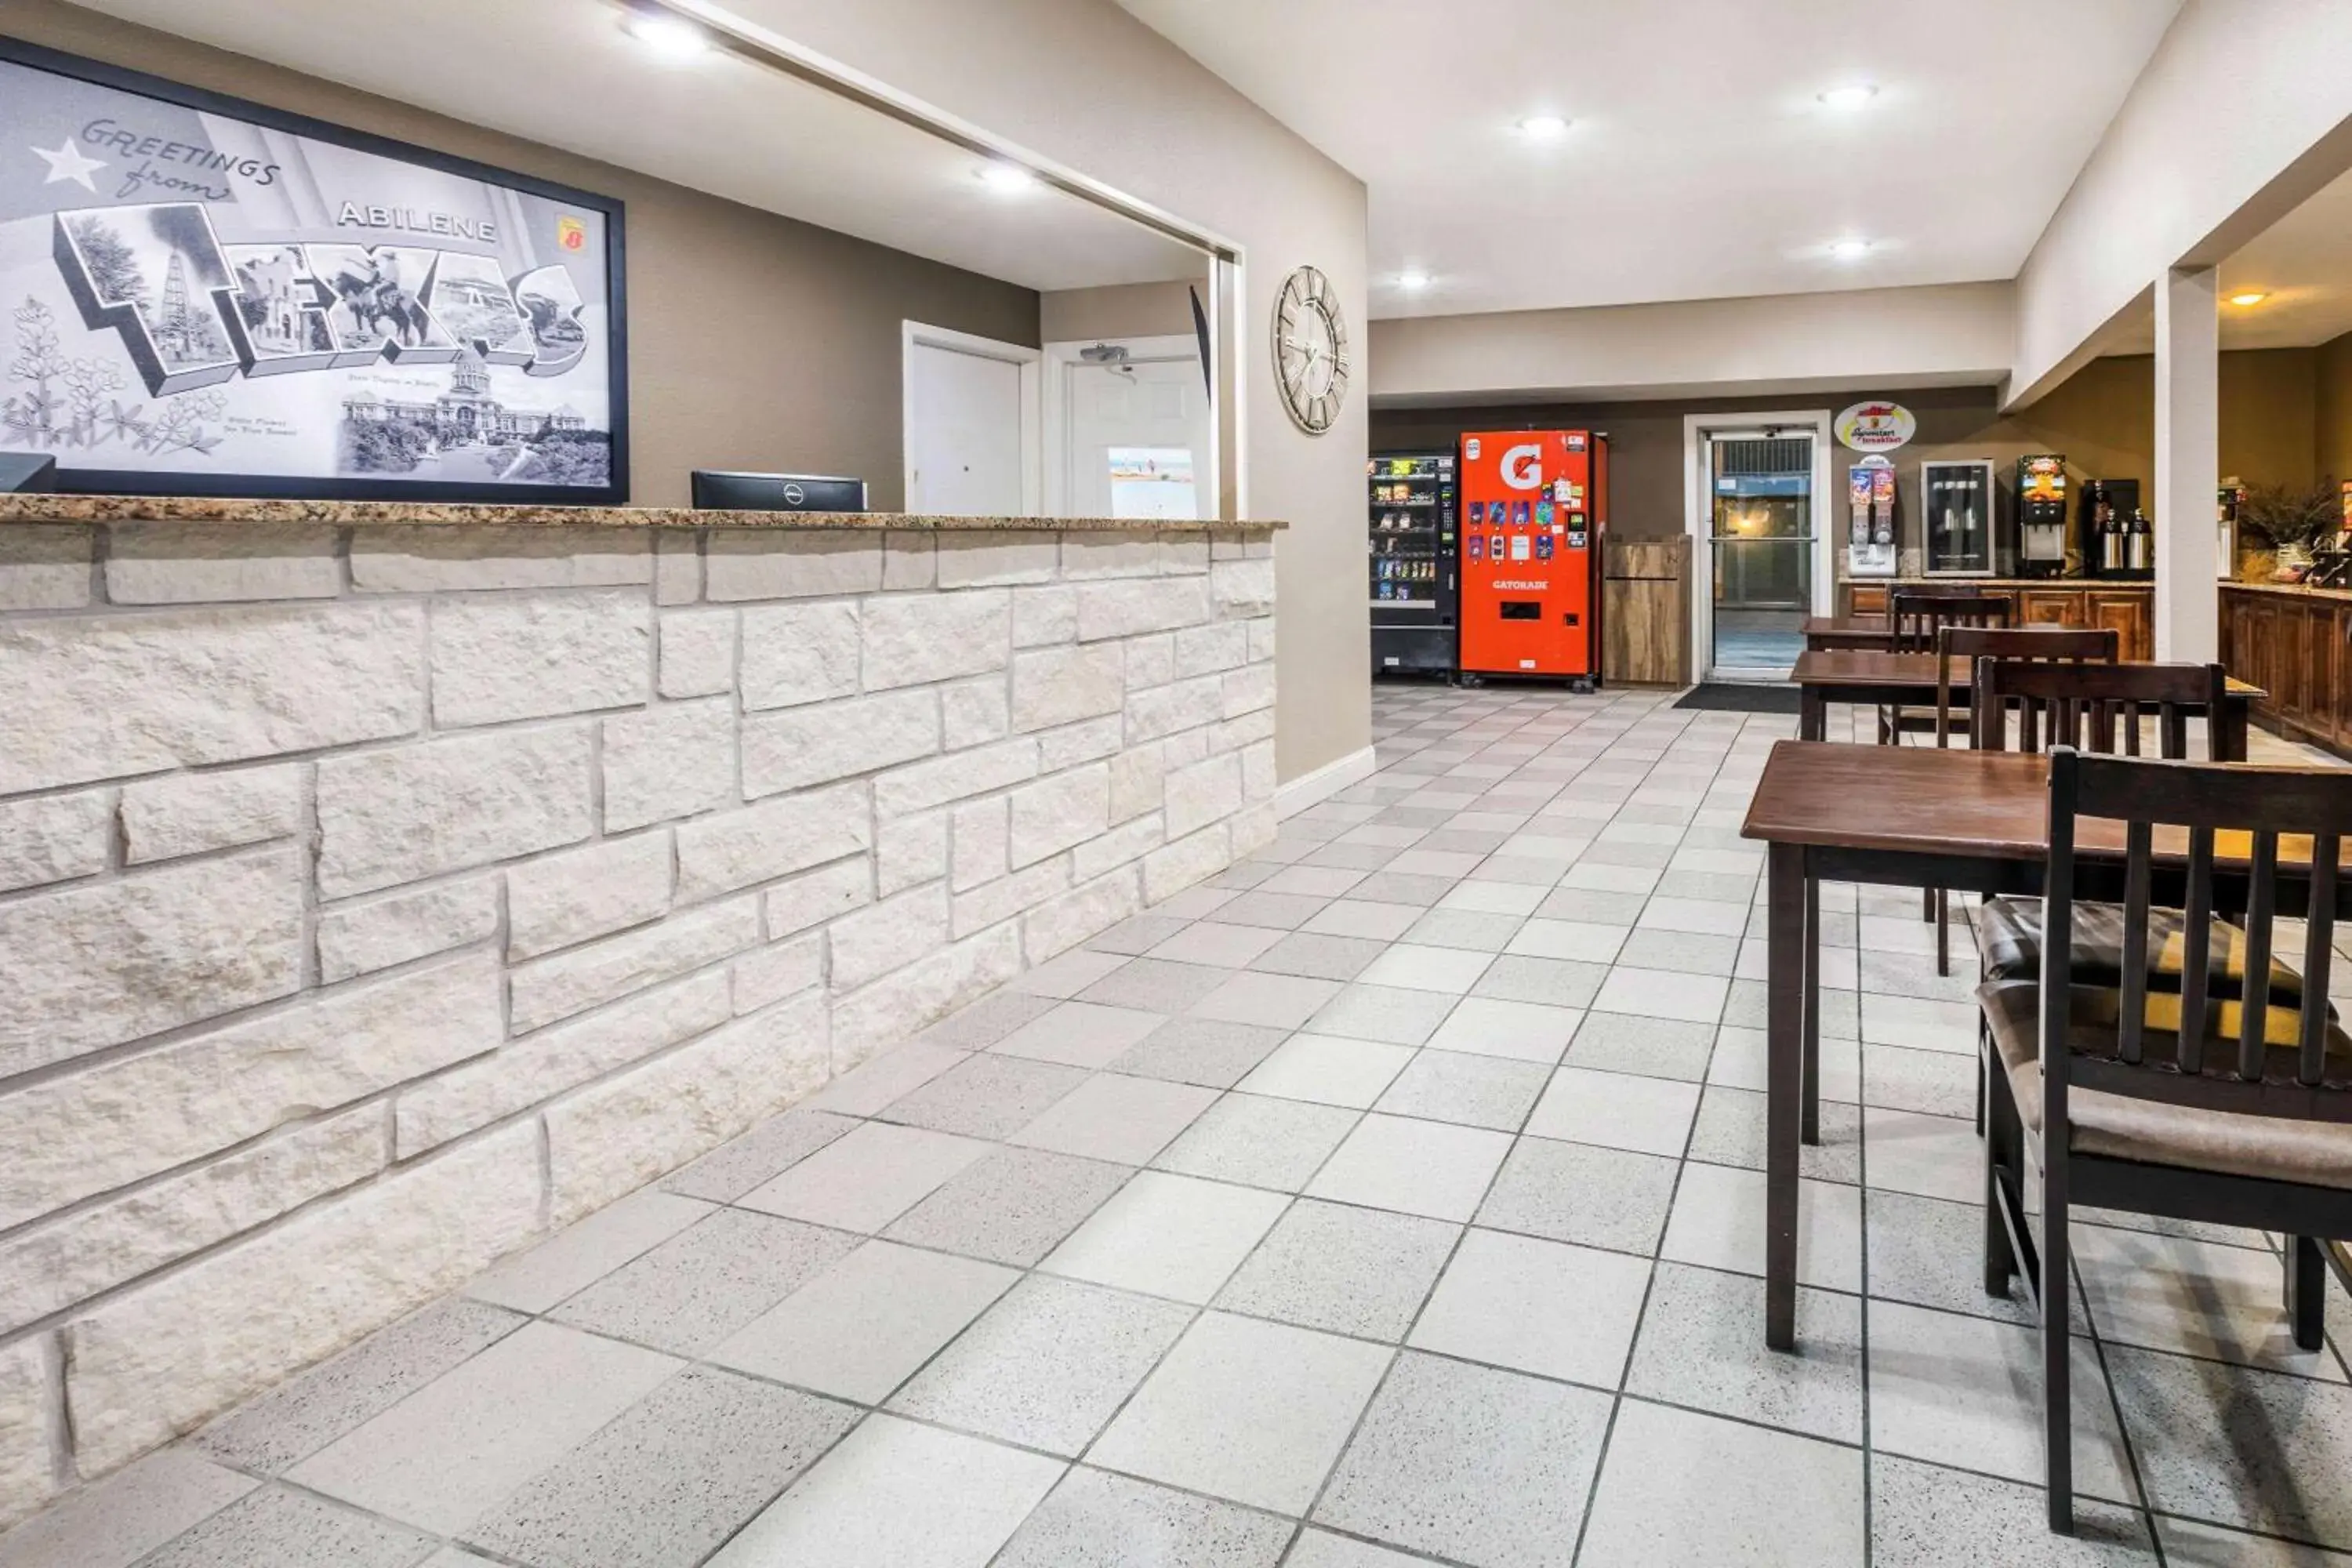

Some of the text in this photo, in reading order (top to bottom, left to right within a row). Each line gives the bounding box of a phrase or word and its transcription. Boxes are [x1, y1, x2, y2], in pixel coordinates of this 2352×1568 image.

[82, 118, 281, 186] GREETINGS
[116, 160, 230, 199] from
[337, 201, 497, 243] ABILENE
[53, 202, 588, 398] TEXAS
[1500, 443, 1542, 491] G
[1492, 579, 1549, 590] GATORADE
